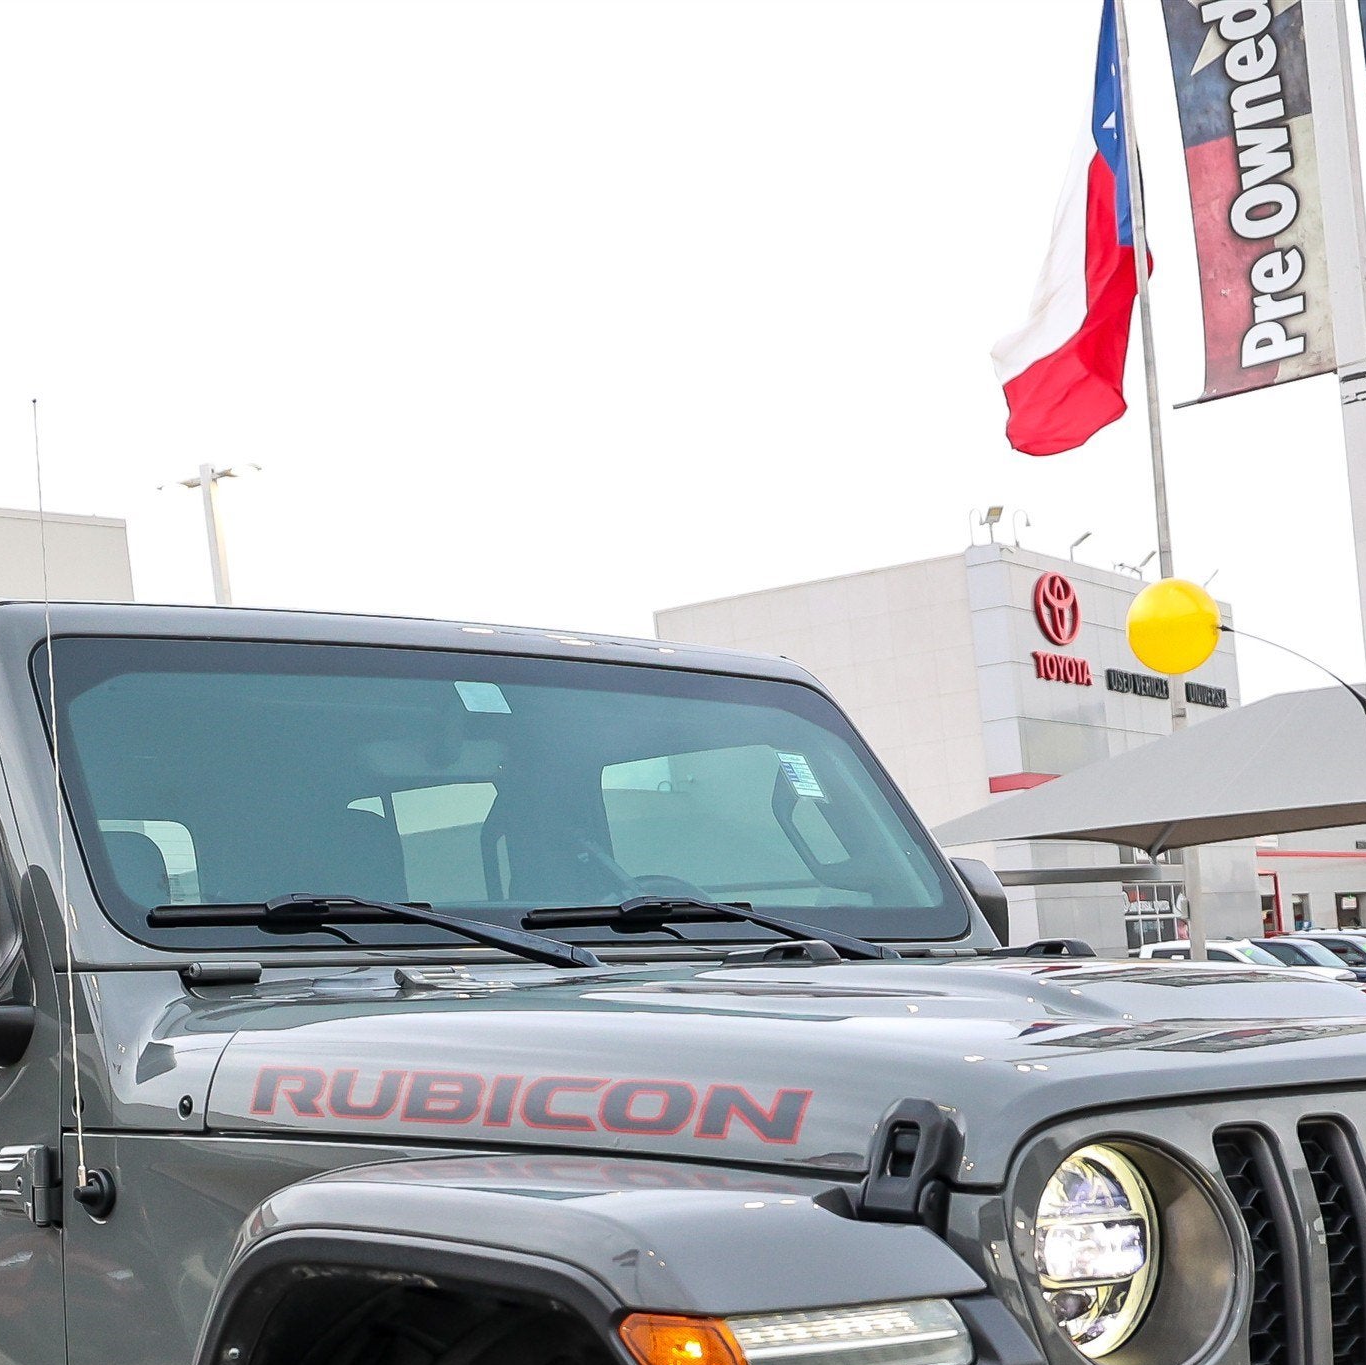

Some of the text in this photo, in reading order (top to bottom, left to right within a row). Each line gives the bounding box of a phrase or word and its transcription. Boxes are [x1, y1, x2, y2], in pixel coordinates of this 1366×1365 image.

[1201, 0, 1306, 368] Pre Owned
[1031, 650, 1093, 686] TOYOTA
[250, 1065, 813, 1144] RUBICON
